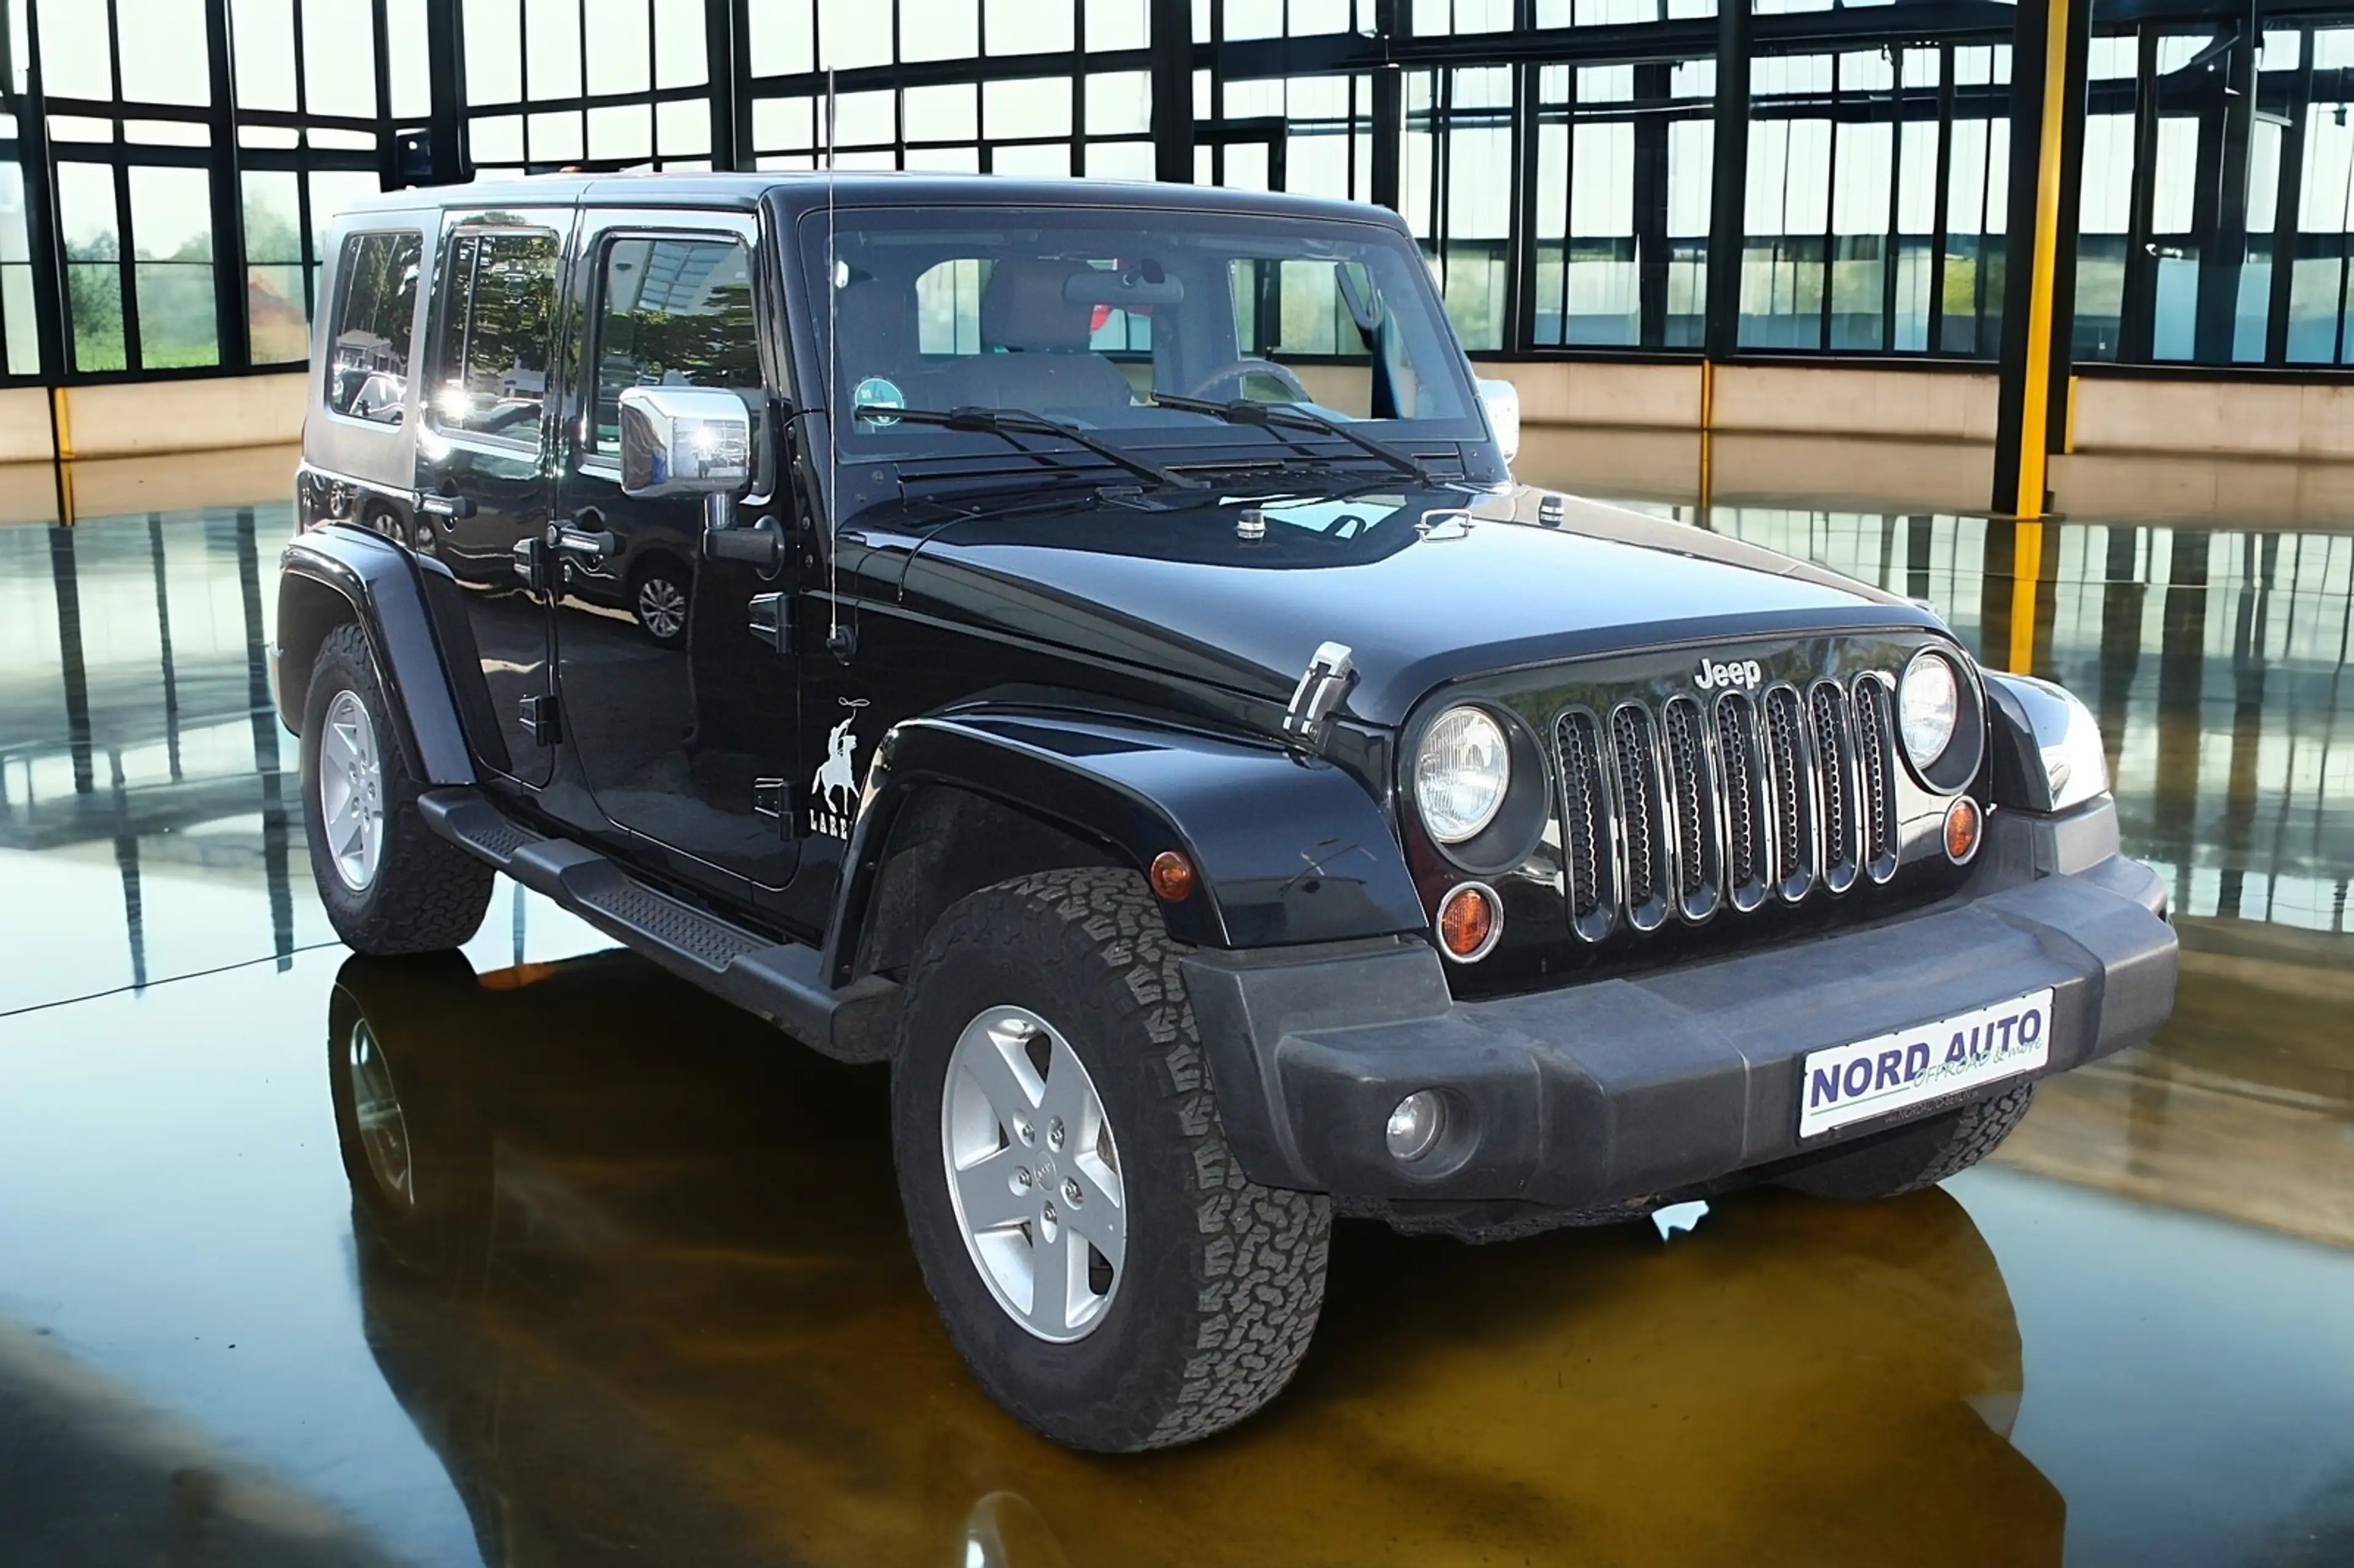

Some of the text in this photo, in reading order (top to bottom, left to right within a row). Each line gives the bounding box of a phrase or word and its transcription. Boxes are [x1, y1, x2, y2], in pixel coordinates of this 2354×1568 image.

[1695, 658, 1761, 690] Jeep
[809, 809, 853, 840] LARE
[1810, 1042, 1930, 1108] NORD
[1945, 1008, 2041, 1064] AUTO
[1913, 1049, 1990, 1088] OFFROAD
[2007, 1037, 2043, 1059] more
